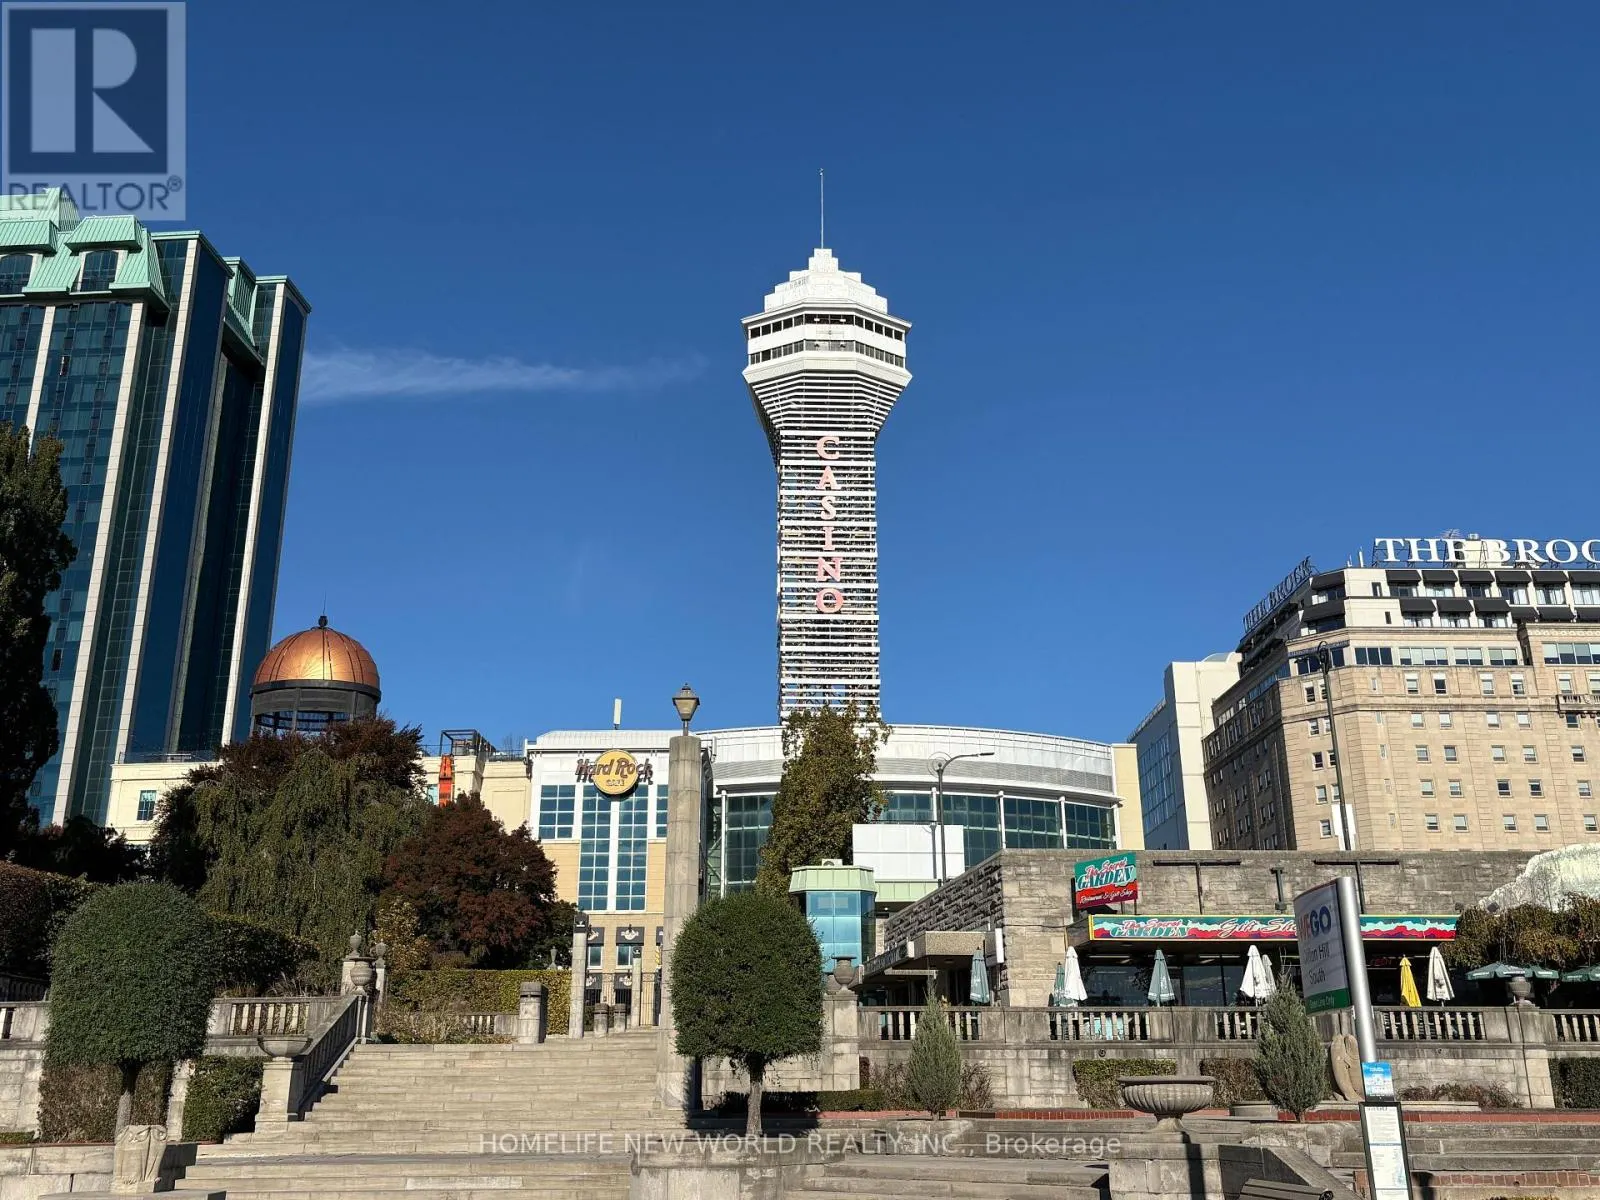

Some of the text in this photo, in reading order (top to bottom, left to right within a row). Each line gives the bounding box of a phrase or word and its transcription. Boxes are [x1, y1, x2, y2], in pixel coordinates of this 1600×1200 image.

[815, 436, 844, 614] CASINO
[1374, 538, 1467, 562] THE
[575, 757, 653, 779] Hard Rock
[1077, 865, 1135, 890] GARDEN
[1110, 926, 1190, 938] GARDEN
[1122, 918, 1182, 930] The Secret
[1218, 918, 1298, 938] Gift Sho
[1308, 968, 1326, 985] South
